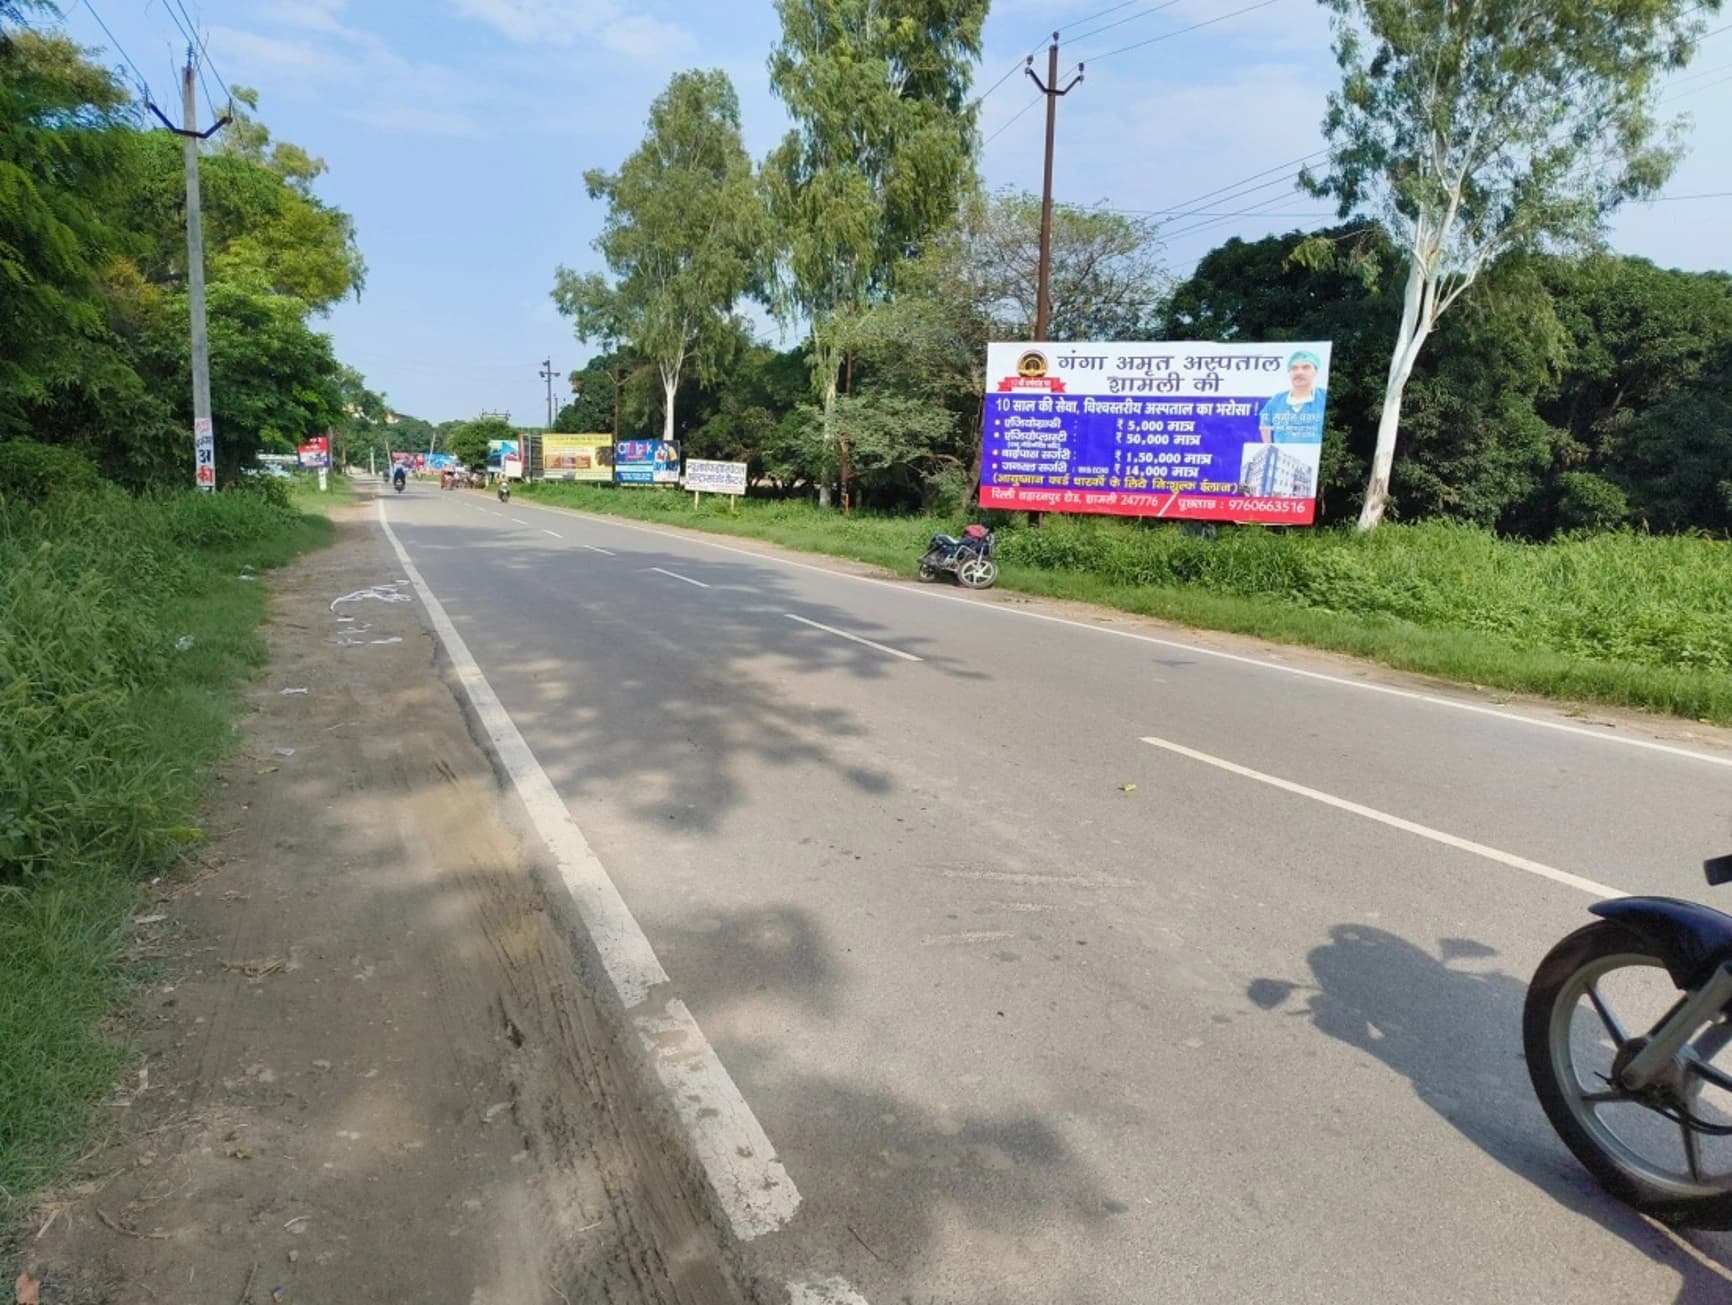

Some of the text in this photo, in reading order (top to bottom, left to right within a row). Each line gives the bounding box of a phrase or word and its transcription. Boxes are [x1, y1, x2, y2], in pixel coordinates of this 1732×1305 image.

[1056, 349, 1284, 377] गंगा अमृत अस्पताल
[1107, 371, 1225, 393] शामली की
[996, 398, 1010, 411] 10
[1013, 399, 1035, 412] साल
[1038, 396, 1053, 412] की
[1056, 396, 1079, 414] सेवा,
[1084, 397, 1142, 415] विश्वस्तरीय
[1145, 401, 1194, 416] अस्पताल
[1196, 402, 1213, 416] का
[1216, 400, 1252, 417] भरोसा
[1127, 421, 1164, 431] 5,000
[1167, 421, 1197, 432] मात्र
[1126, 434, 1169, 445] 50,000
[1173, 435, 1202, 446] मात्र
[1127, 453, 1181, 464] 1,50,000
[1184, 454, 1213, 465] मात्र
[1125, 466, 1168, 477] 14,000
[1172, 467, 1200, 477] मात्र
[1121, 495, 1159, 506] 247776
[1228, 500, 1305, 513] 9760663516
